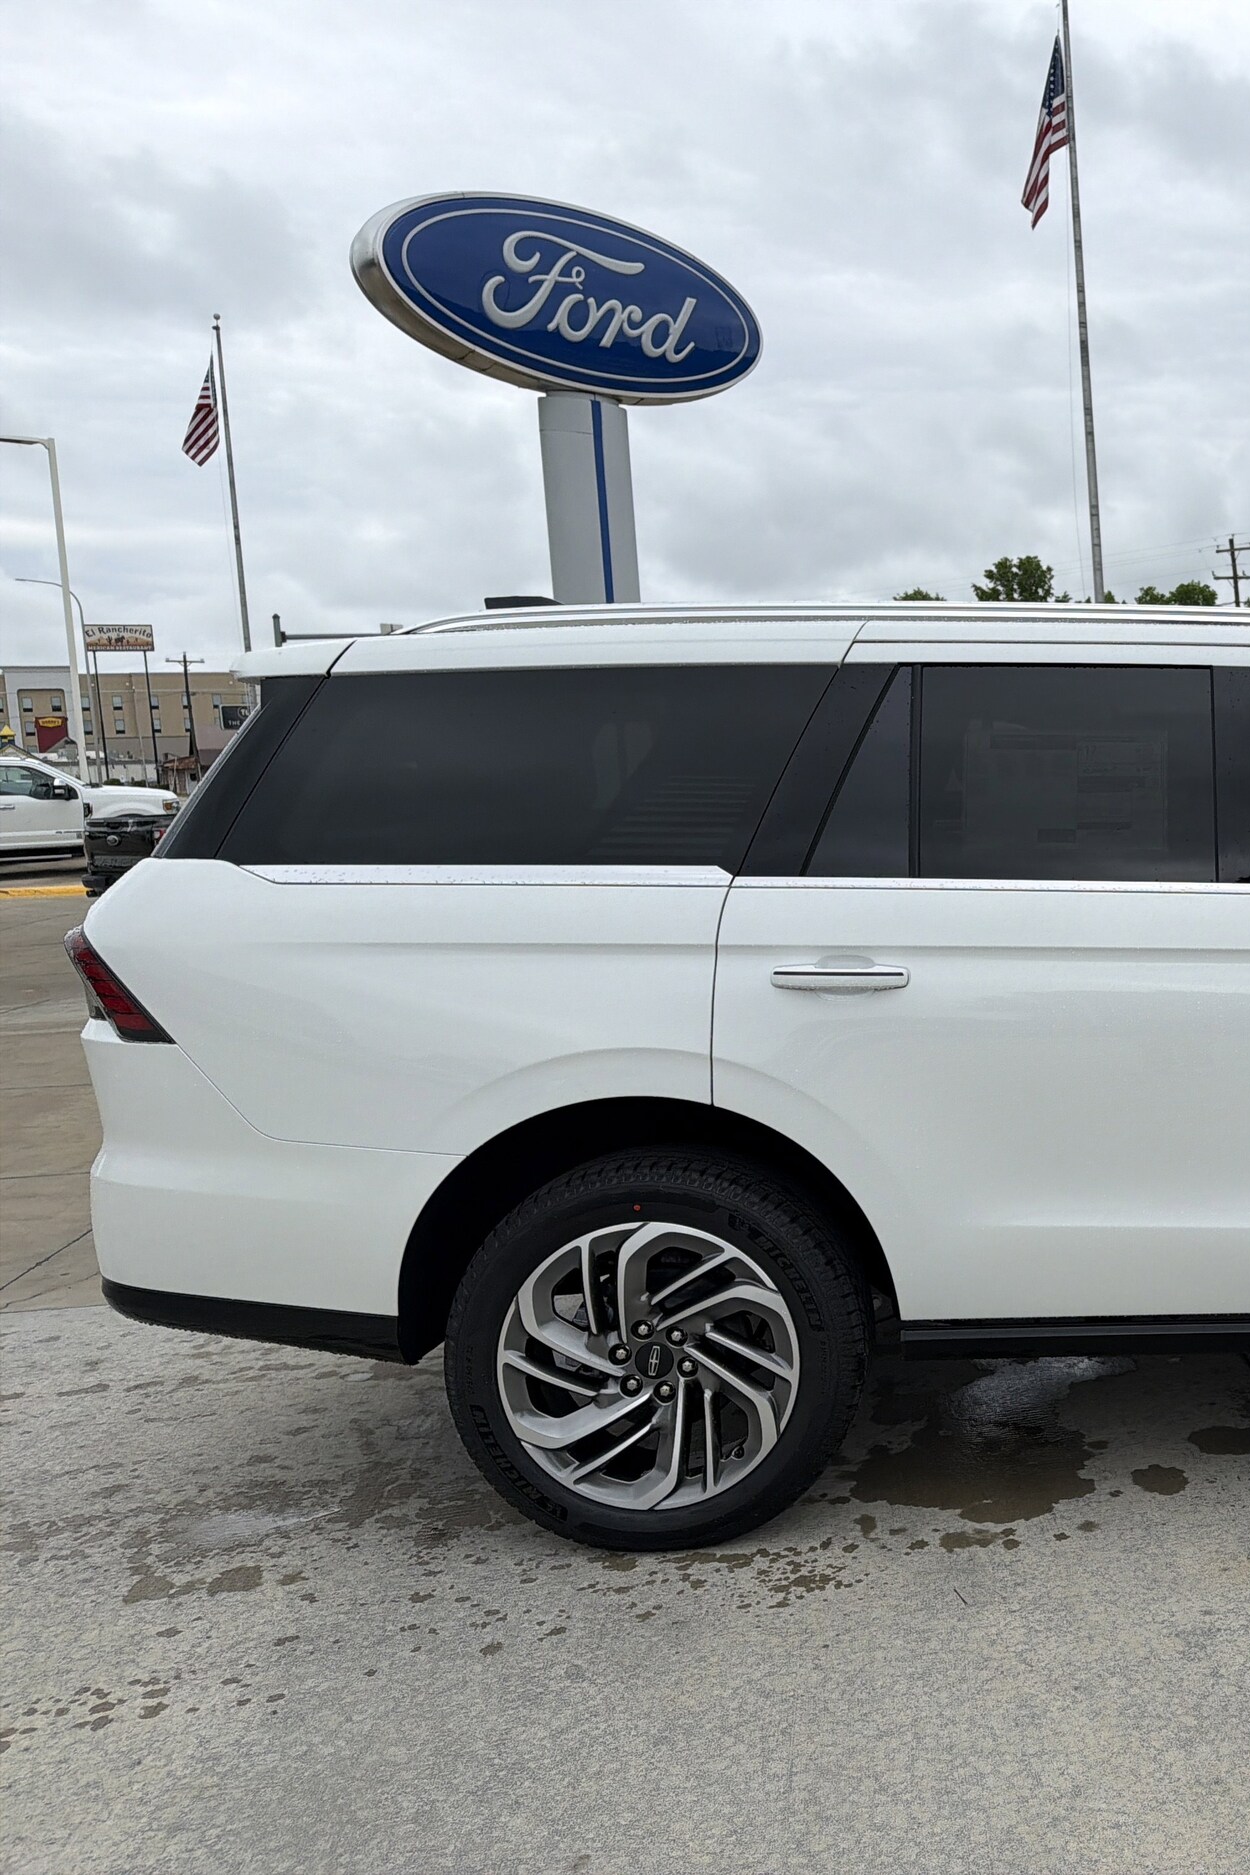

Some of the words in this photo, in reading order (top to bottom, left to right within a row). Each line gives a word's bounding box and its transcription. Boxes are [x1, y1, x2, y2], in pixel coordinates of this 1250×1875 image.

[482, 230, 696, 363] Ford
[85, 628, 95, 637] El
[98, 626, 151, 638] Rancherito
